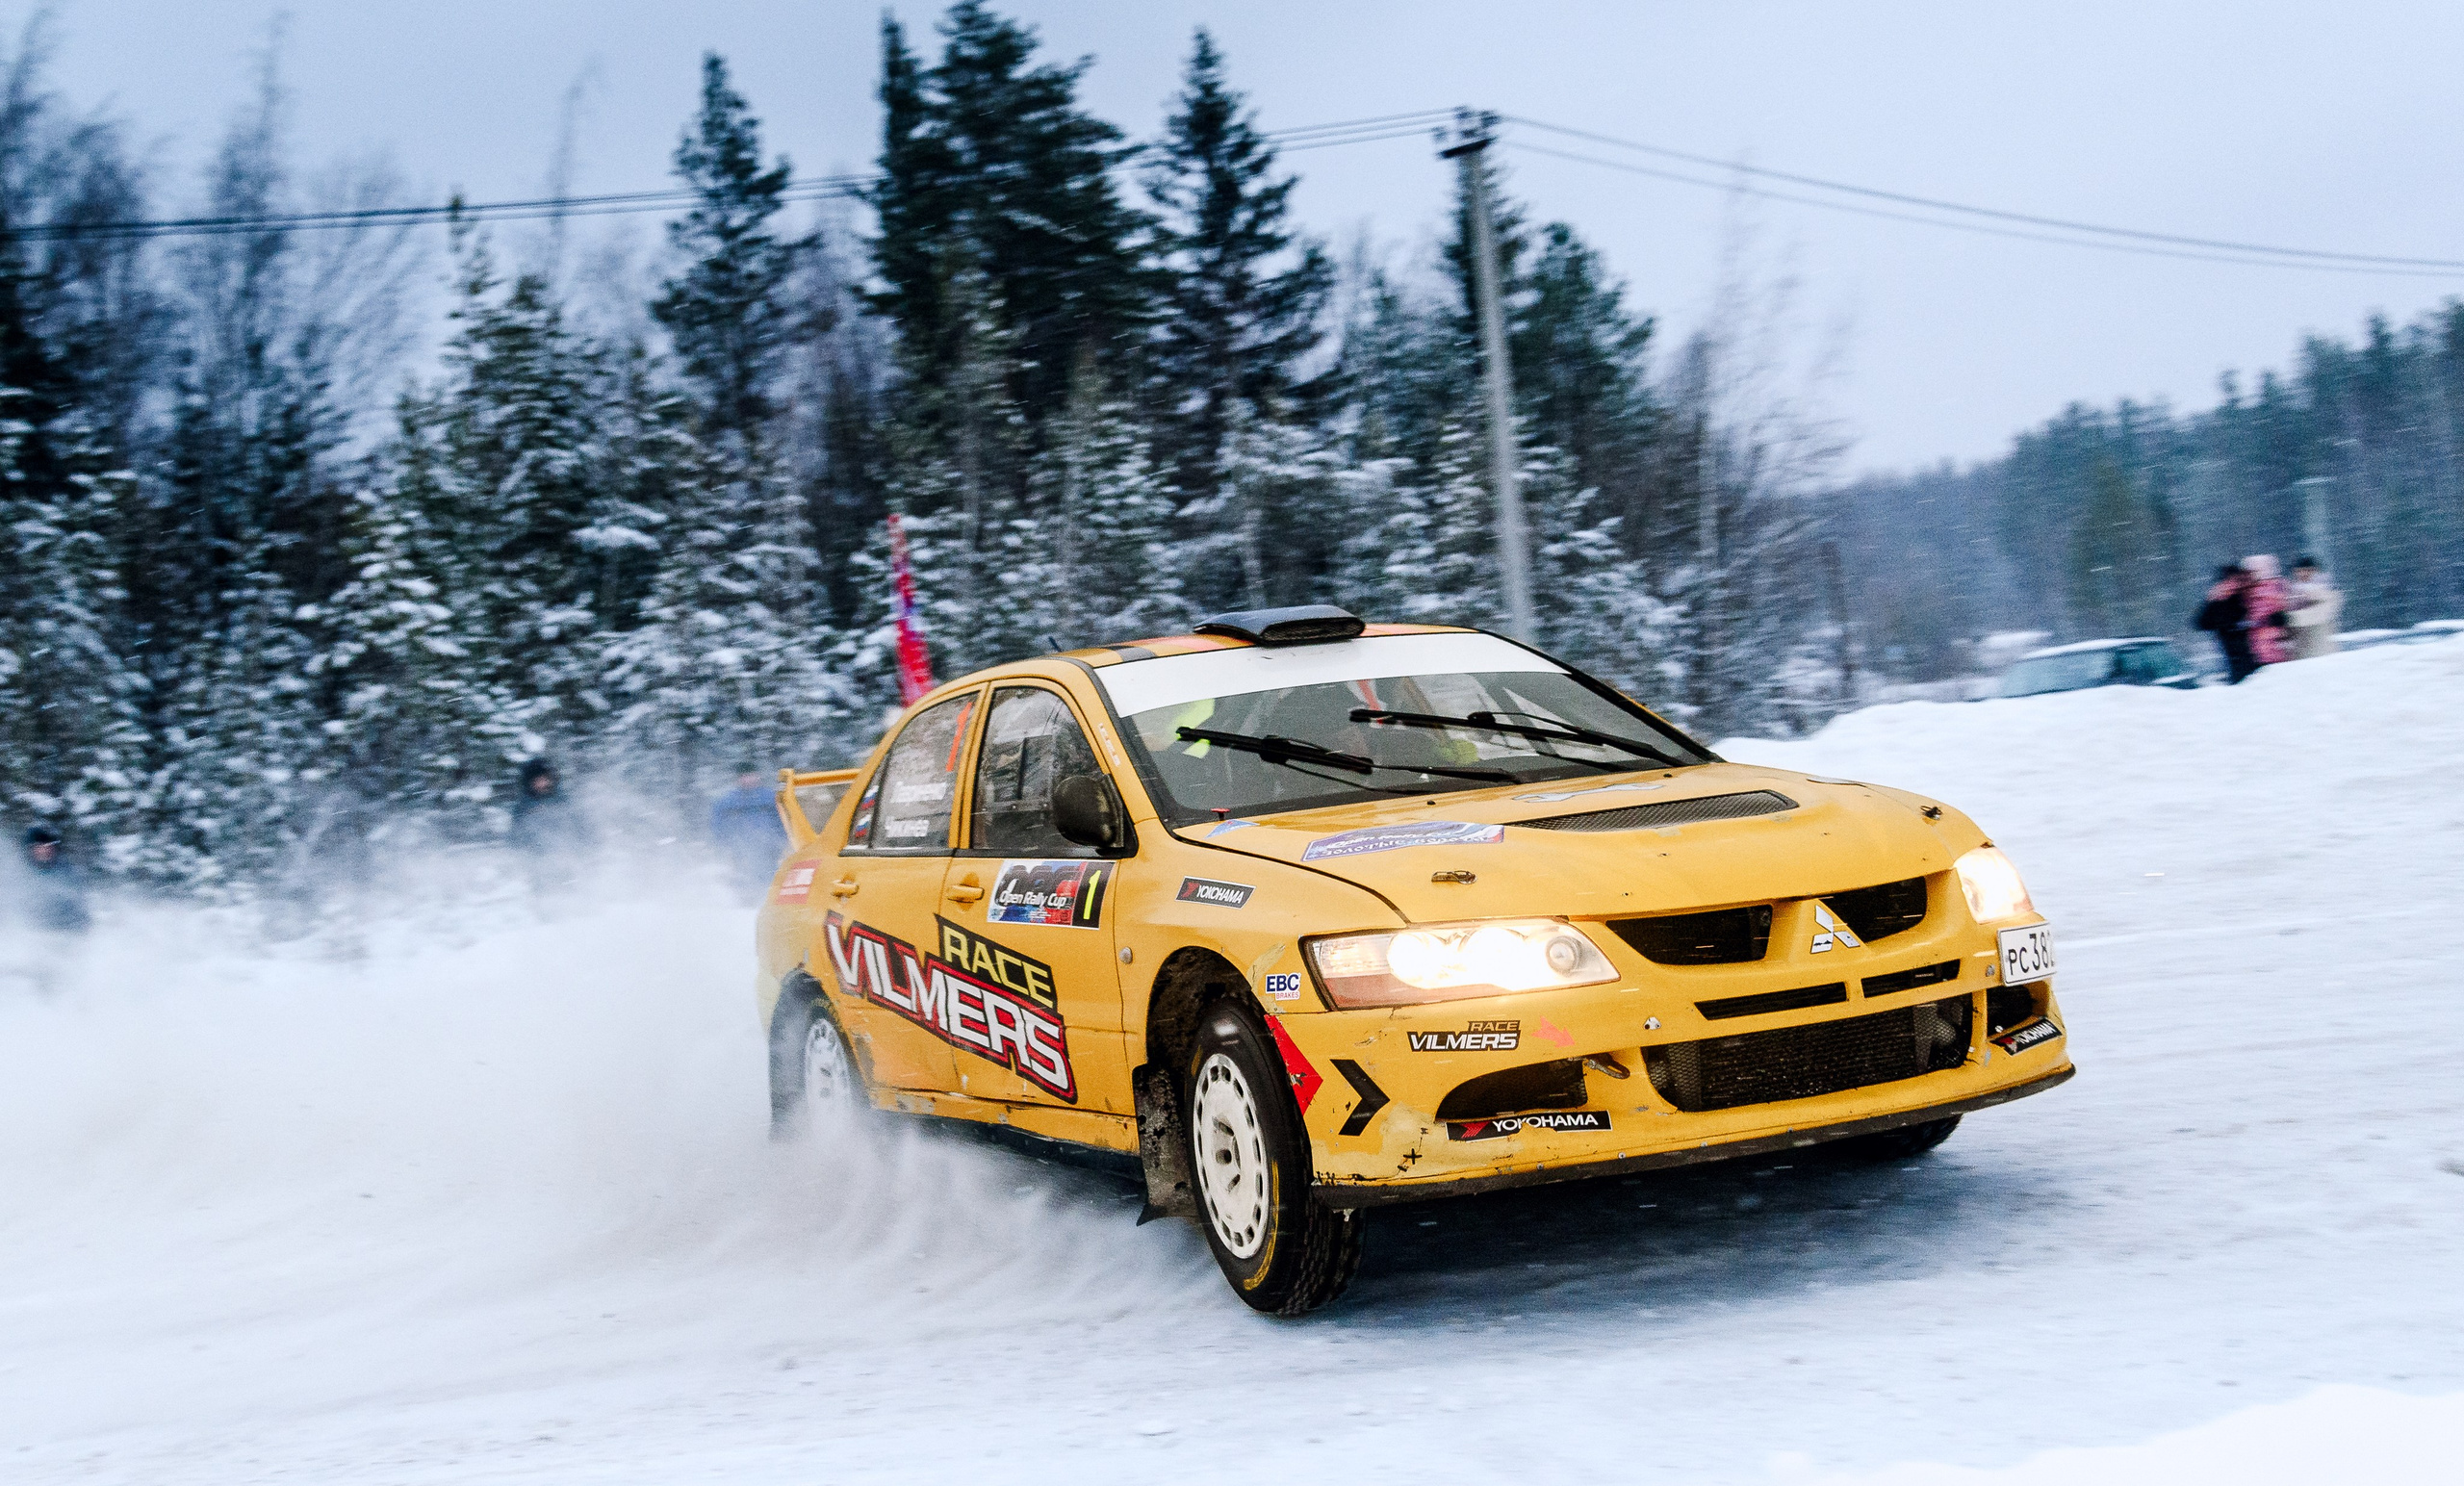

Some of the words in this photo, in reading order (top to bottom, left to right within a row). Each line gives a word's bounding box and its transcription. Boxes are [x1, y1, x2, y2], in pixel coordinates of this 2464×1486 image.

[1000, 890, 1023, 906] Open
[1024, 892, 1047, 909] Rally
[1048, 893, 1066, 908] Cup
[1084, 869, 1101, 919] 1
[1196, 884, 1245, 904] YOKOHAMA
[943, 925, 1054, 1008] RACE
[1266, 973, 1299, 992] EBC
[828, 924, 1069, 1089] VILMERS
[1471, 1021, 1519, 1032] RACE
[1410, 1033, 1518, 1050] VILMERS
[1492, 1114, 1599, 1133] YOKOHAMA
